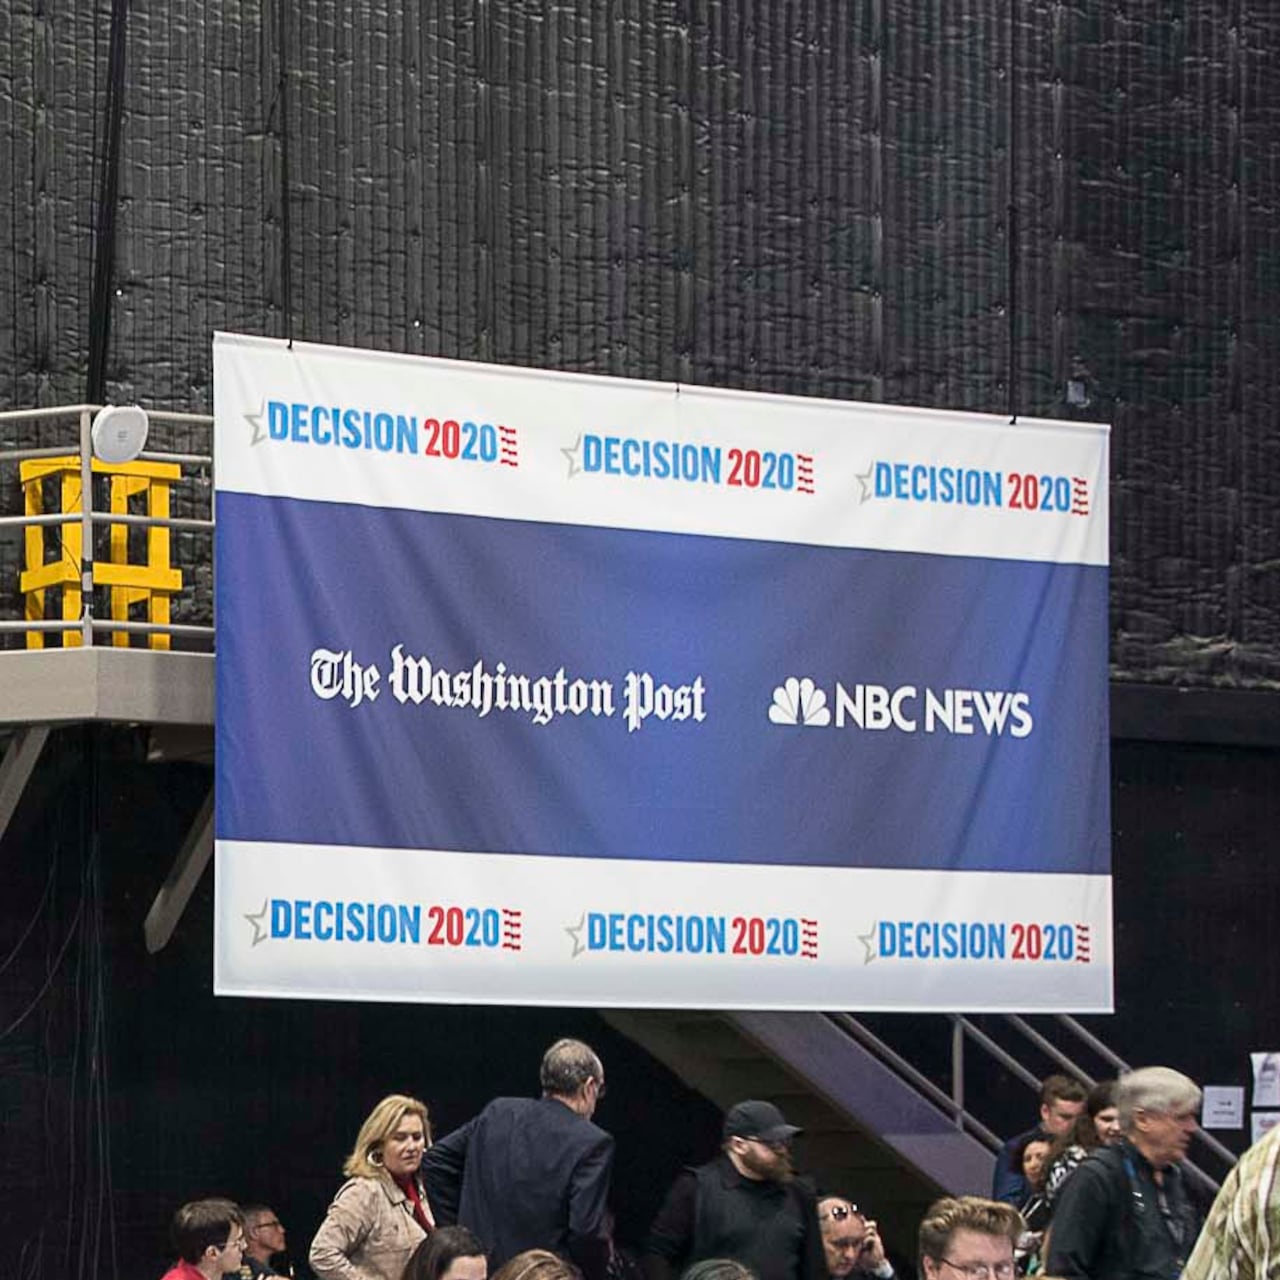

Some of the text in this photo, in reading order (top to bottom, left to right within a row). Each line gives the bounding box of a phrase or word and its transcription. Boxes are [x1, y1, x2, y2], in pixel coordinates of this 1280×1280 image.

[268, 401, 498, 462] DECISION 2020
[584, 435, 795, 490] DECISION 2020
[876, 463, 1071, 512] DECISION 2020
[311, 644, 707, 733] The Washington Post
[836, 683, 1033, 738] NBC NEWS
[271, 899, 500, 948] DECISION 2020
[589, 913, 800, 956] DECISION 2020
[880, 921, 1074, 961] DECISION 2020
